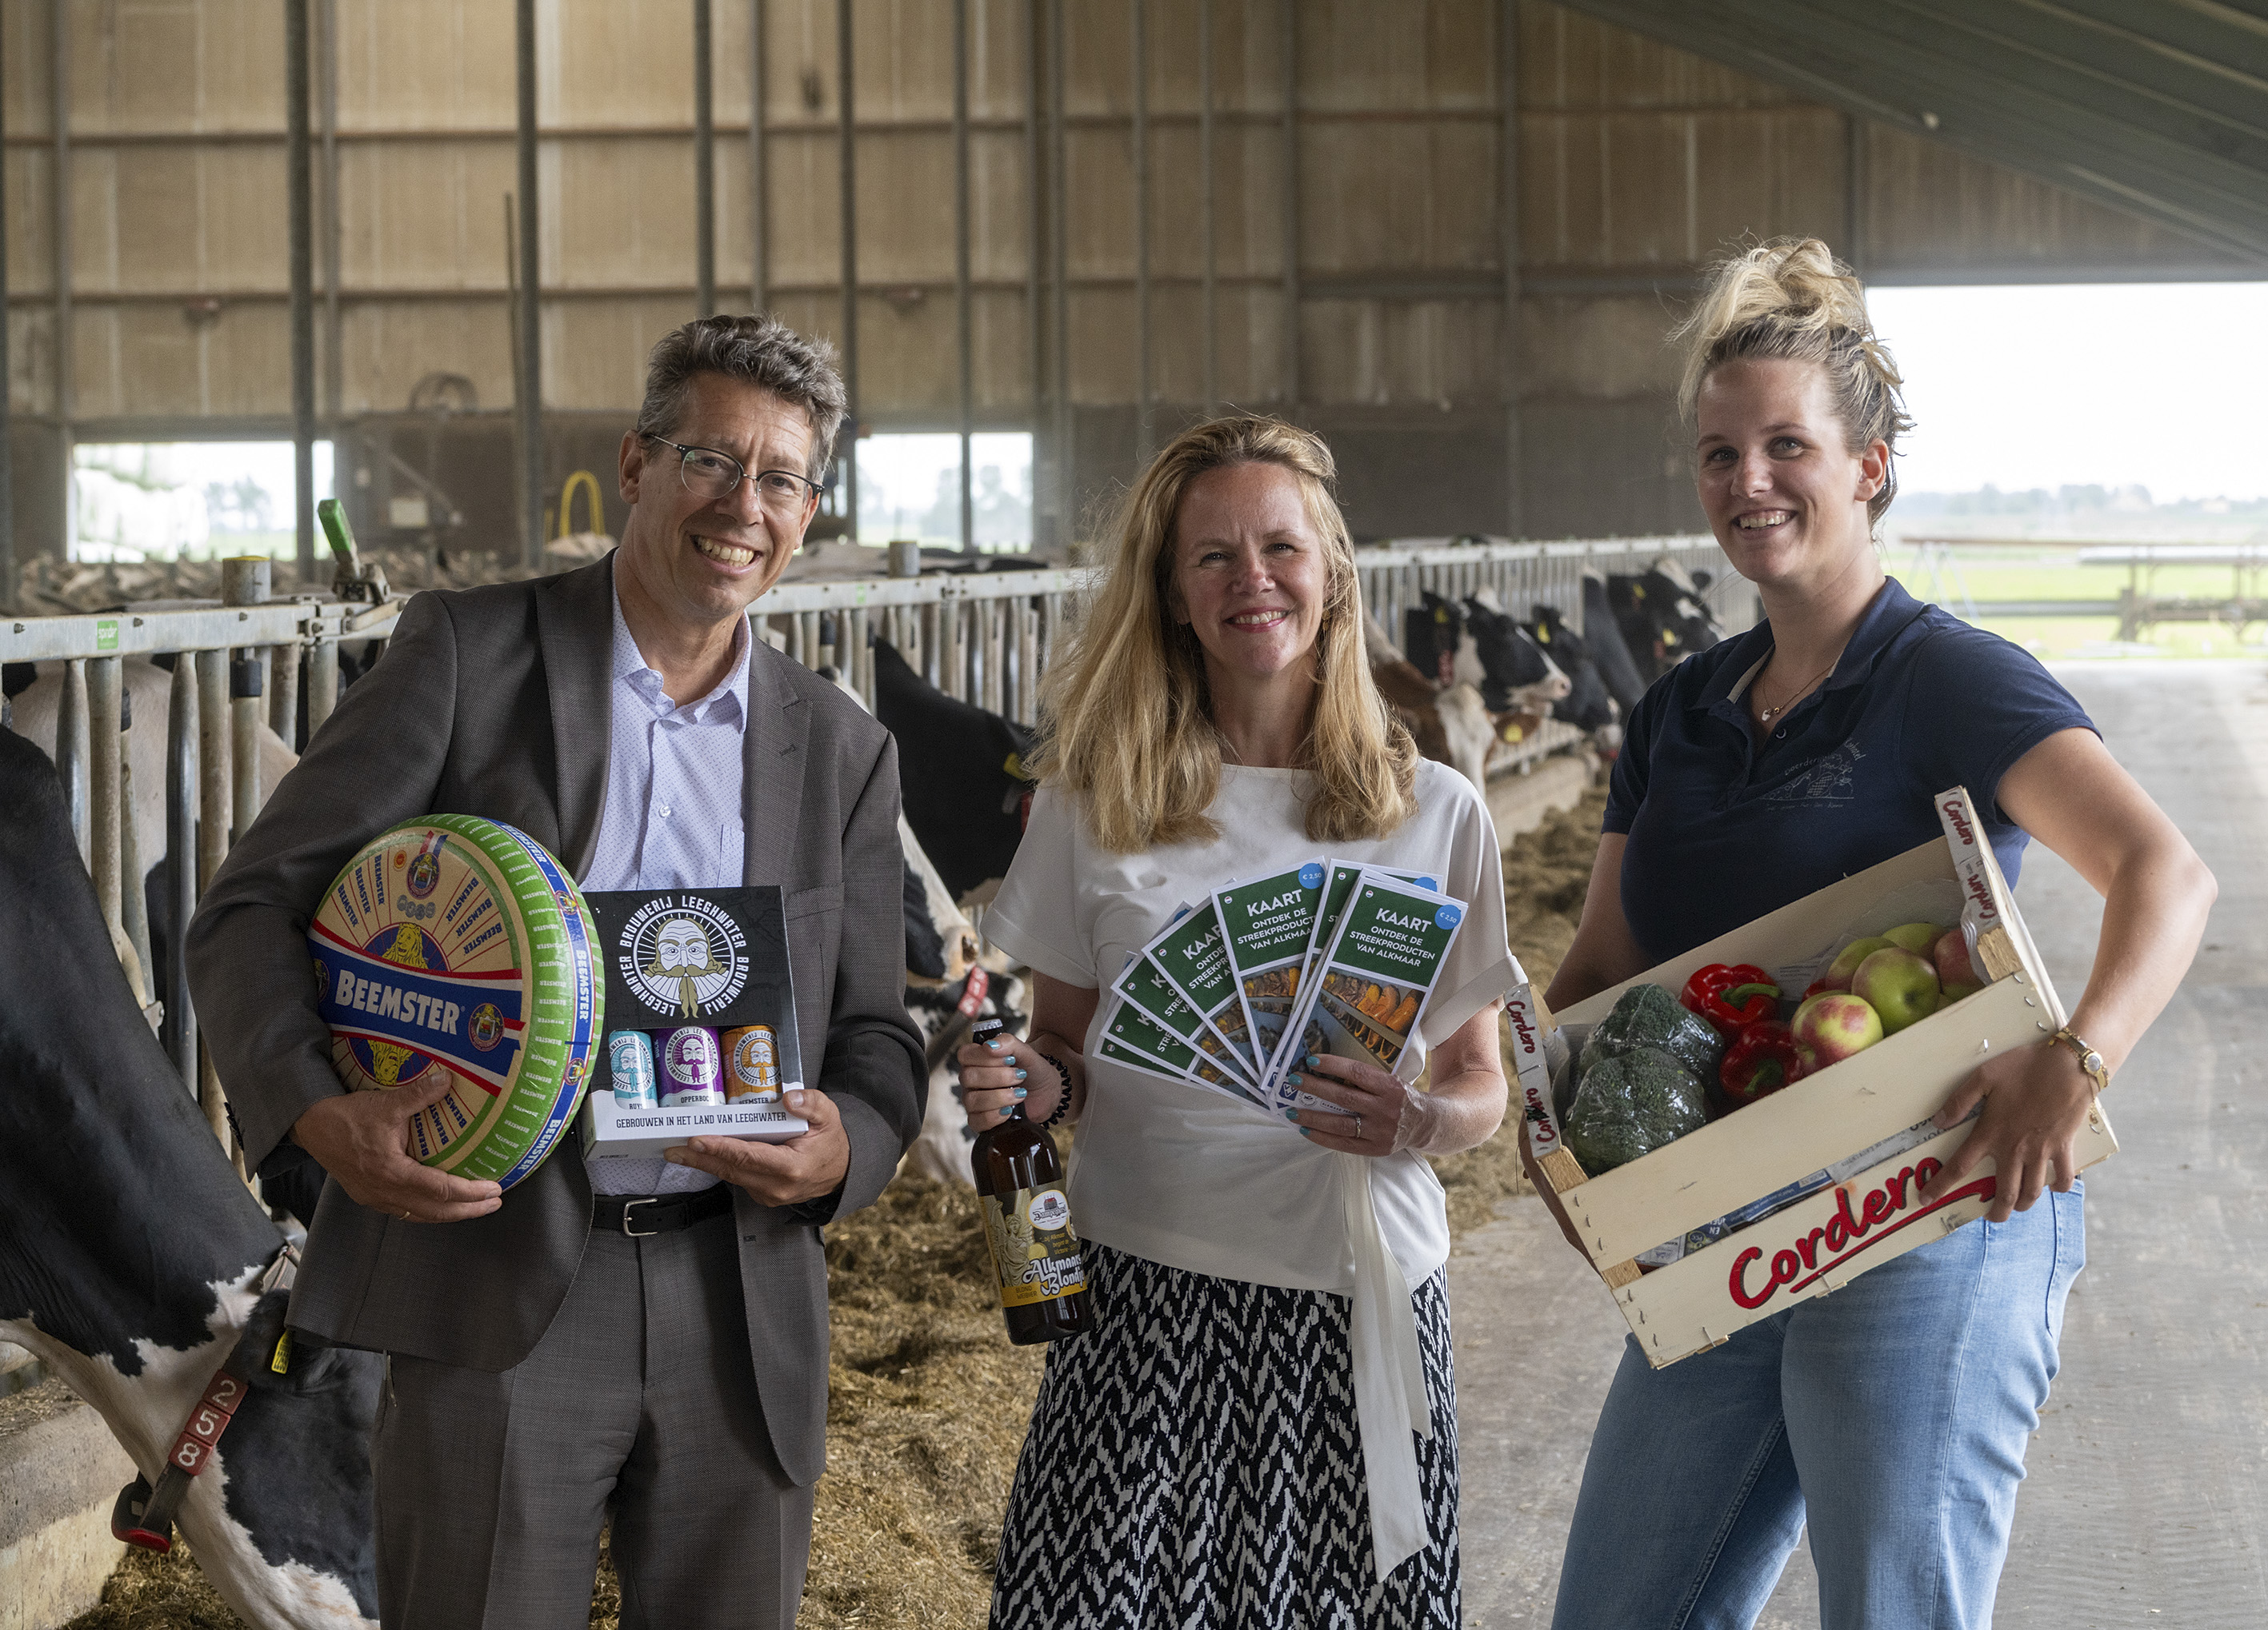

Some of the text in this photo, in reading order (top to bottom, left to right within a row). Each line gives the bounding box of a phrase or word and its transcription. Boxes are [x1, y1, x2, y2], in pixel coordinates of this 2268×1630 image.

[1942, 801, 1974, 845] Cordero
[502, 825, 547, 862] BEEMSTER
[355, 867, 371, 914] BEEMSTER
[374, 854, 385, 905] BEEMSTER
[1967, 873, 1998, 919] Cordero
[338, 883, 358, 927] BEEMSTER
[446, 877, 479, 922] BEEMSTER
[1247, 889, 1302, 917] KAART
[455, 897, 493, 937] BEEMSTER
[1238, 916, 1316, 944] STREEKPRODUCT
[1252, 908, 1307, 929] ONTDEK DE
[1376, 908, 1432, 933] KAART
[1446, 914, 1458, 923] 2,50
[463, 922, 503, 954] BEEMSTER
[1182, 924, 1223, 960] KAAR
[1250, 928, 1312, 949] VAN ALKMAA
[1350, 931, 1435, 960] STREEKPRODUCTEN
[1371, 926, 1423, 945] ONTDEK DE
[619, 895, 749, 1017] BROUWERIJ LEEGHWATER BROUWERIJ LEEGHWATER
[1196, 945, 1226, 969] ONTDE
[1357, 944, 1421, 966] VAN ALKMAAR
[576, 950, 590, 1020] BEEMSTER
[1189, 955, 1229, 989] STREEKPR
[1204, 974, 1223, 989] VAN
[334, 969, 461, 1035] BEEMSTER
[535, 1036, 562, 1045] BEEMSTER
[667, 1029, 690, 1053] BROUWERIJ
[1506, 1001, 1536, 1054] Cordero
[530, 1054, 557, 1066] BEEMSTER
[520, 1088, 546, 1100] BEEMSTER
[526, 1073, 552, 1084] BEEMSTER
[444, 1093, 467, 1129] BEEMST
[681, 1095, 710, 1104] OPPERBOC
[428, 1104, 450, 1145] BEEMST
[617, 1112, 786, 1128] GEBROUWEN IN HET LAND VAN LEEGHWATER
[518, 1120, 562, 1170] BEEMSTER
[1729, 1157, 1942, 1309] Cordero
[178, 1380, 238, 1467] 258
